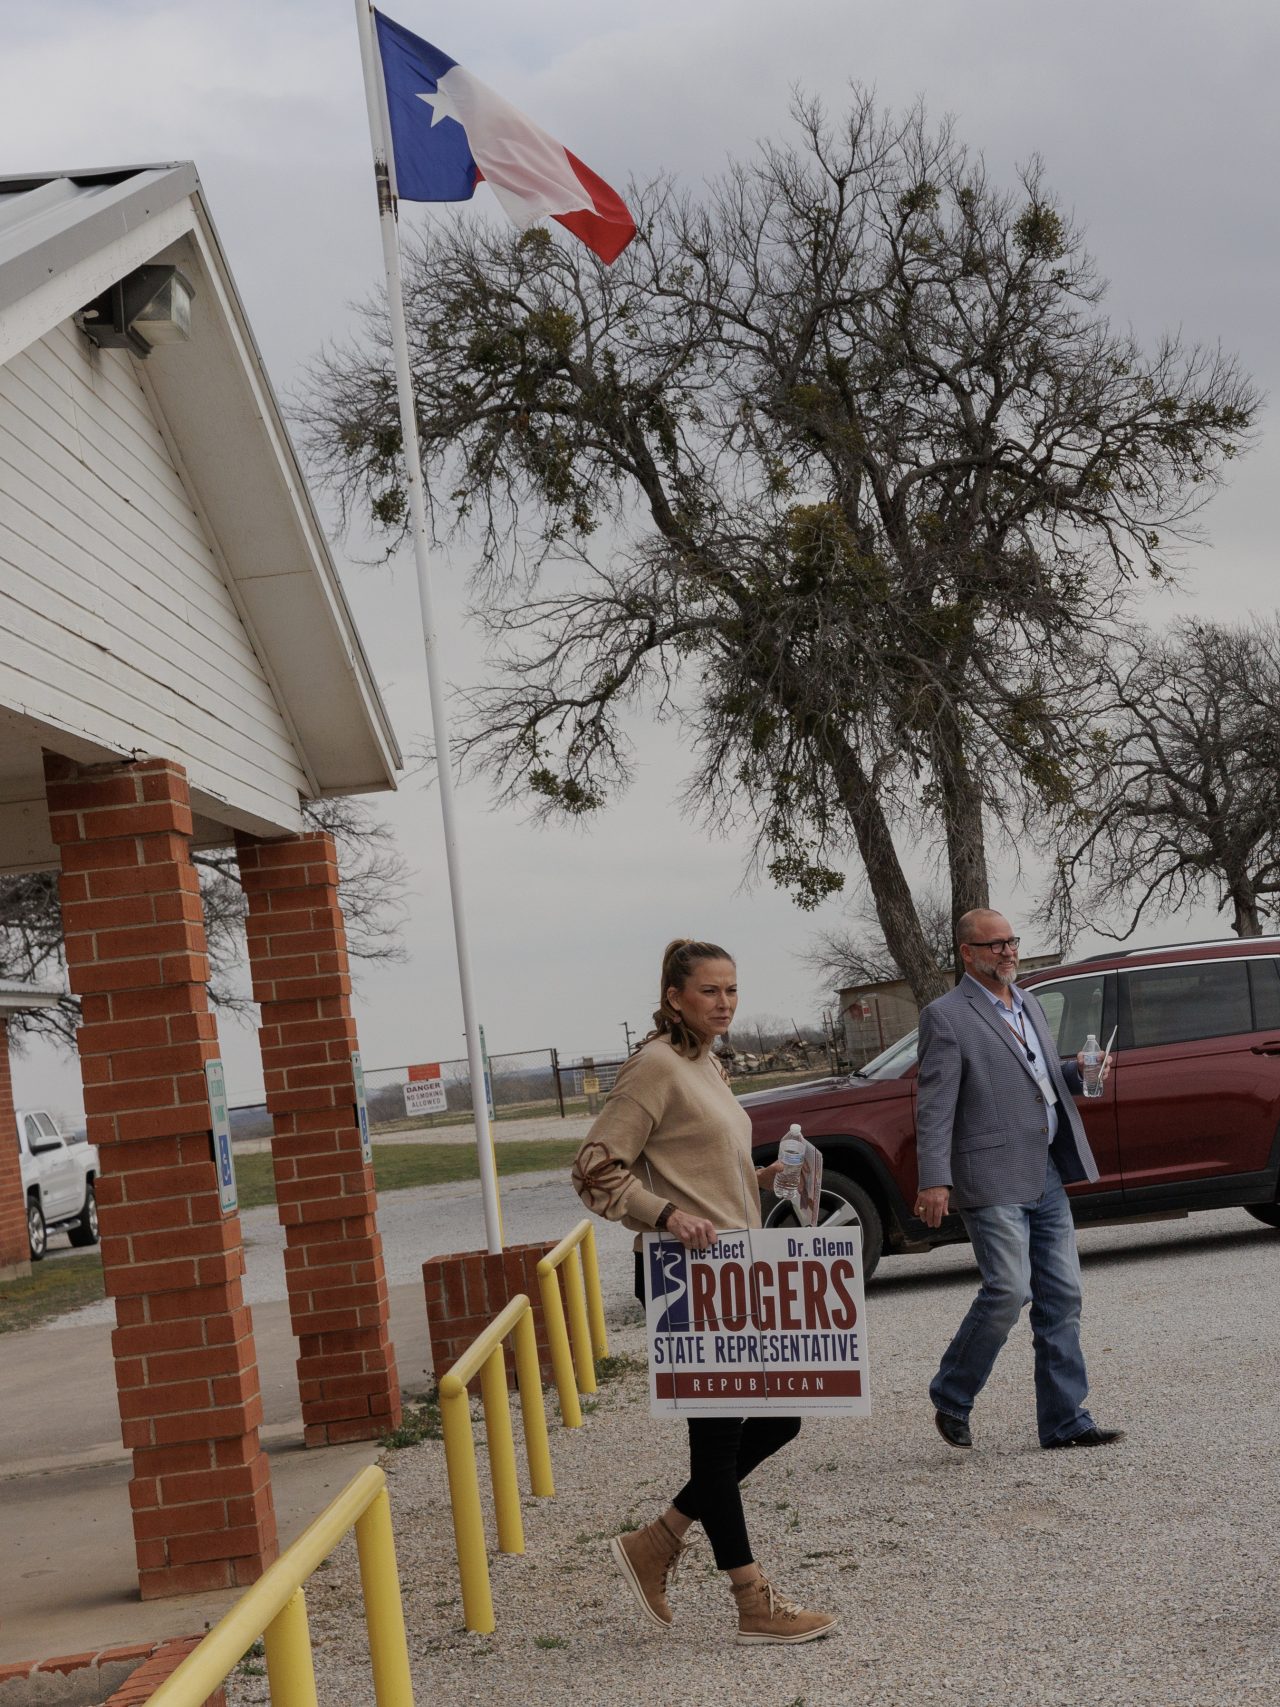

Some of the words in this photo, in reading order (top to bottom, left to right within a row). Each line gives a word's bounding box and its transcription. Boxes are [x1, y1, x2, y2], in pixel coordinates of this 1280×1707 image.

[407, 1082, 441, 1093] DANGER
[416, 1090, 443, 1099] SMOKING
[412, 1098, 441, 1107] ALLOWED
[787, 1239, 808, 1257] Dr.
[813, 1238, 854, 1257] Glenn
[691, 1259, 857, 1332] ROGERS
[655, 1336, 705, 1364] STATE
[716, 1334, 859, 1363] REPRESENTATIVE
